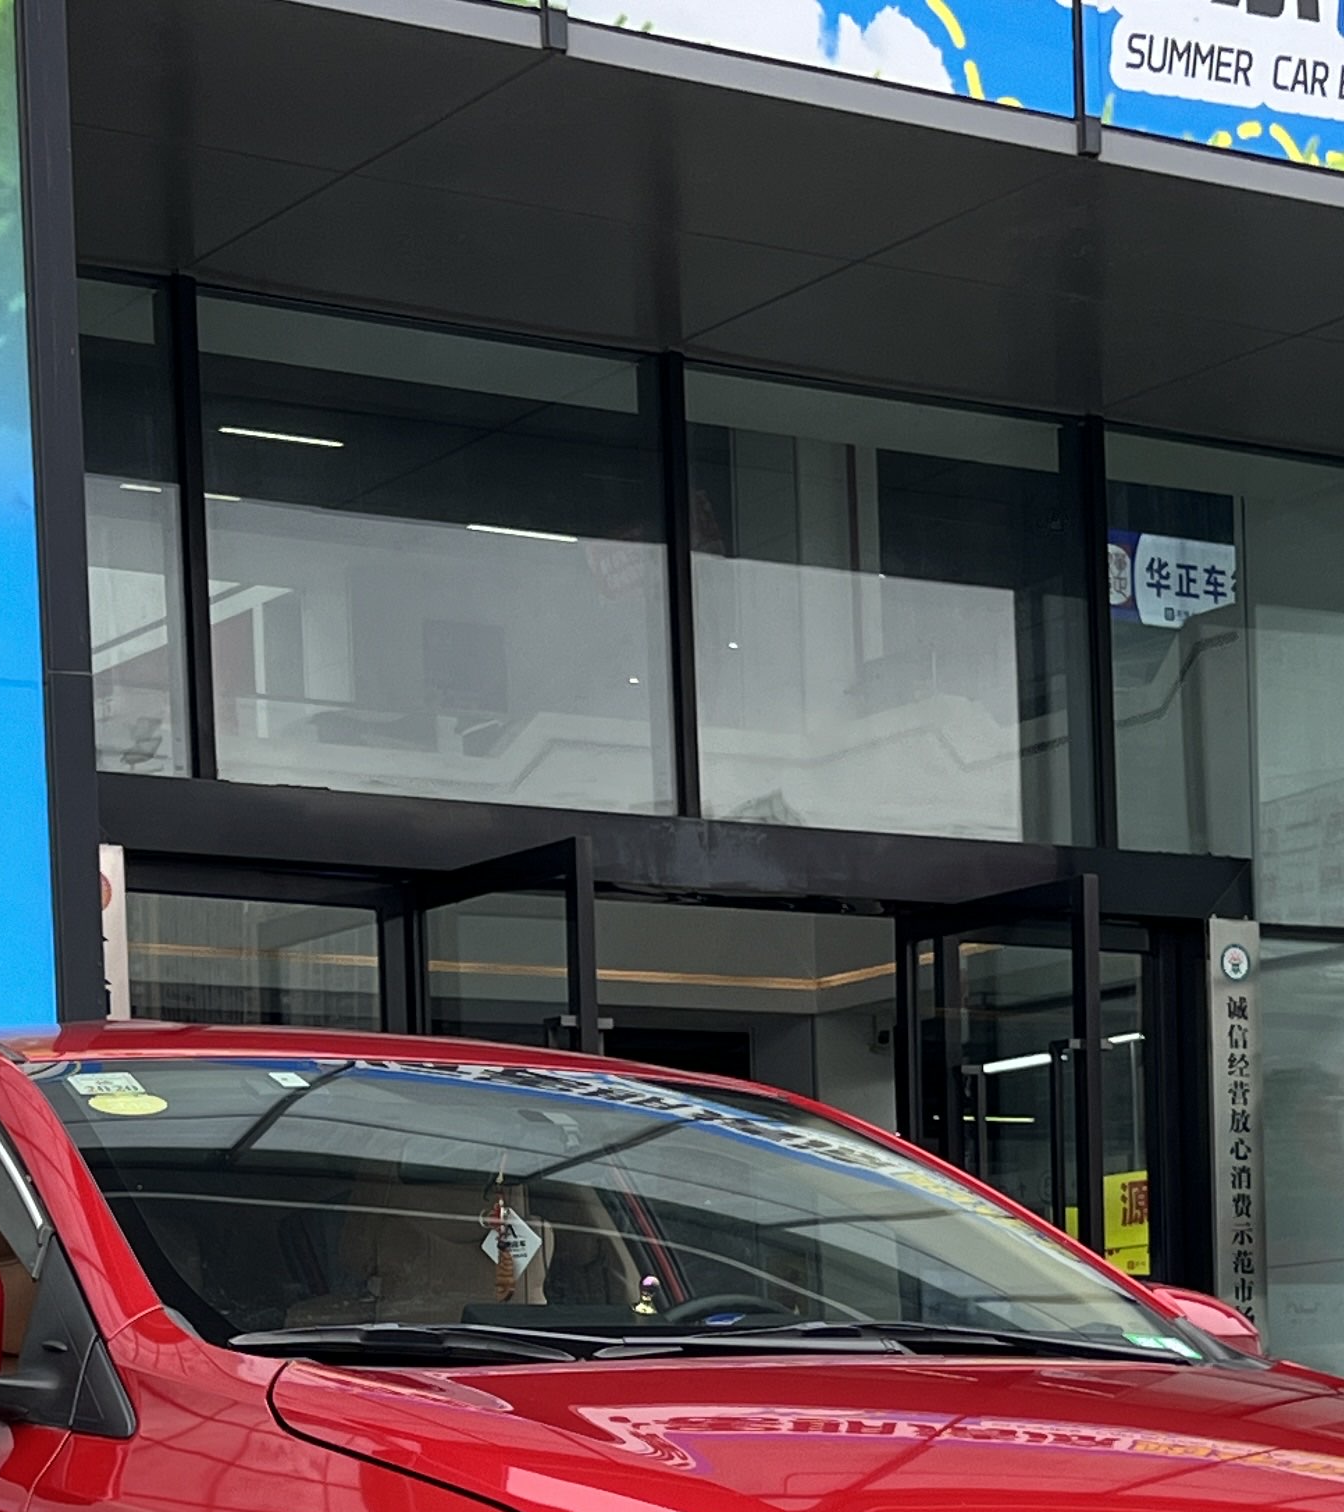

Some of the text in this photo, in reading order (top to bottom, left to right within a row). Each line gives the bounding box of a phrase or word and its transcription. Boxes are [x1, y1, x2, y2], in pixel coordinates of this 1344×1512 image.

[1126, 33, 1253, 87] SUMMER
[1273, 55, 1330, 98] CAR
[1145, 556, 1236, 605] 华正车
